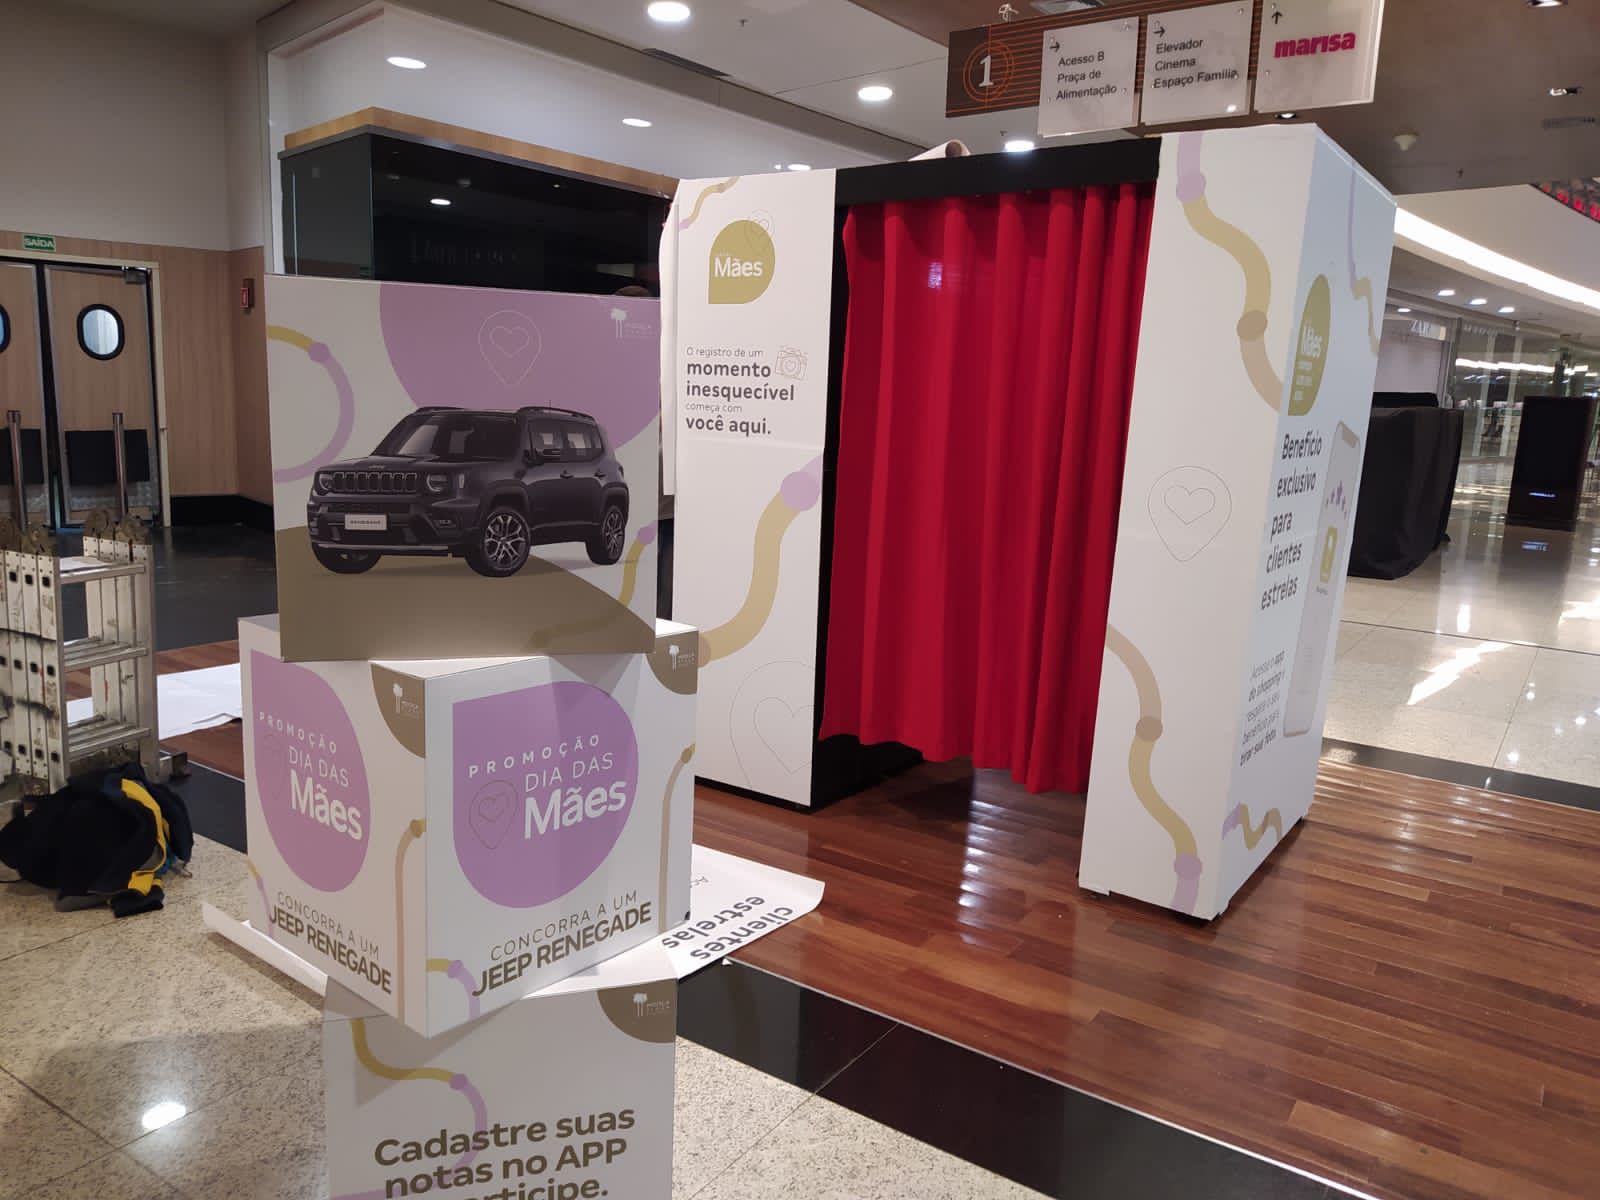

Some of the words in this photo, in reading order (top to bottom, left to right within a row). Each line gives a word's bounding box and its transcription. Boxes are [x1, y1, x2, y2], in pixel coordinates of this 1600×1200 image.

[1058, 54, 1094, 67] Acesso
[1097, 51, 1105, 62] B
[1156, 38, 1204, 54] Elevador
[1273, 32, 1356, 58] marisa
[979, 55, 994, 87] 1
[1057, 71, 1086, 85] Praça
[1089, 69, 1101, 80] de
[1155, 58, 1196, 72] Cinema
[1056, 84, 1117, 100] Alimentação
[1153, 74, 1194, 89] Espaço
[714, 256, 764, 278] Mães
[687, 347, 694, 356] O
[696, 347, 732, 358] registro
[734, 348, 746, 358] de
[748, 350, 764, 358] um
[687, 362, 771, 378] momento
[686, 380, 794, 402] inesquecível
[686, 402, 720, 413] começa
[722, 403, 742, 413] com
[686, 414, 724, 431] você
[729, 418, 771, 437] aqui.
[1282, 431, 1322, 460] Benefício
[1277, 467, 1316, 498] exclusivo
[1271, 511, 1293, 541] para
[1266, 542, 1302, 574] clientes
[1261, 575, 1299, 610] estrelas
[259, 712, 336, 753] PROMOÇÃO
[289, 746, 312, 771] DIA
[319, 759, 348, 787] DAS
[469, 735, 598, 778] PROMOÇÃO
[525, 767, 562, 792] DIA
[572, 753, 613, 778] DAS
[291, 769, 362, 840] Mães
[524, 781, 627, 840] Mães
[278, 891, 343, 938] CONCORRA
[349, 930, 355, 944] A
[361, 936, 379, 960] UM
[491, 910, 590, 960] CONCORRA
[597, 904, 606, 916] A
[613, 890, 637, 910] UM
[662, 896, 765, 948] estrelas
[690, 907, 792, 960] clientes
[269, 905, 304, 936] JEEP
[307, 924, 391, 994] RENEGADE
[472, 952, 532, 996] JEEP
[537, 902, 652, 969] RENEGADE
[374, 1121, 547, 1166] Cadastre
[556, 1108, 636, 1138] suas
[385, 1162, 493, 1199] notas
[502, 1154, 547, 1179] no
[555, 1138, 627, 1171] APP
